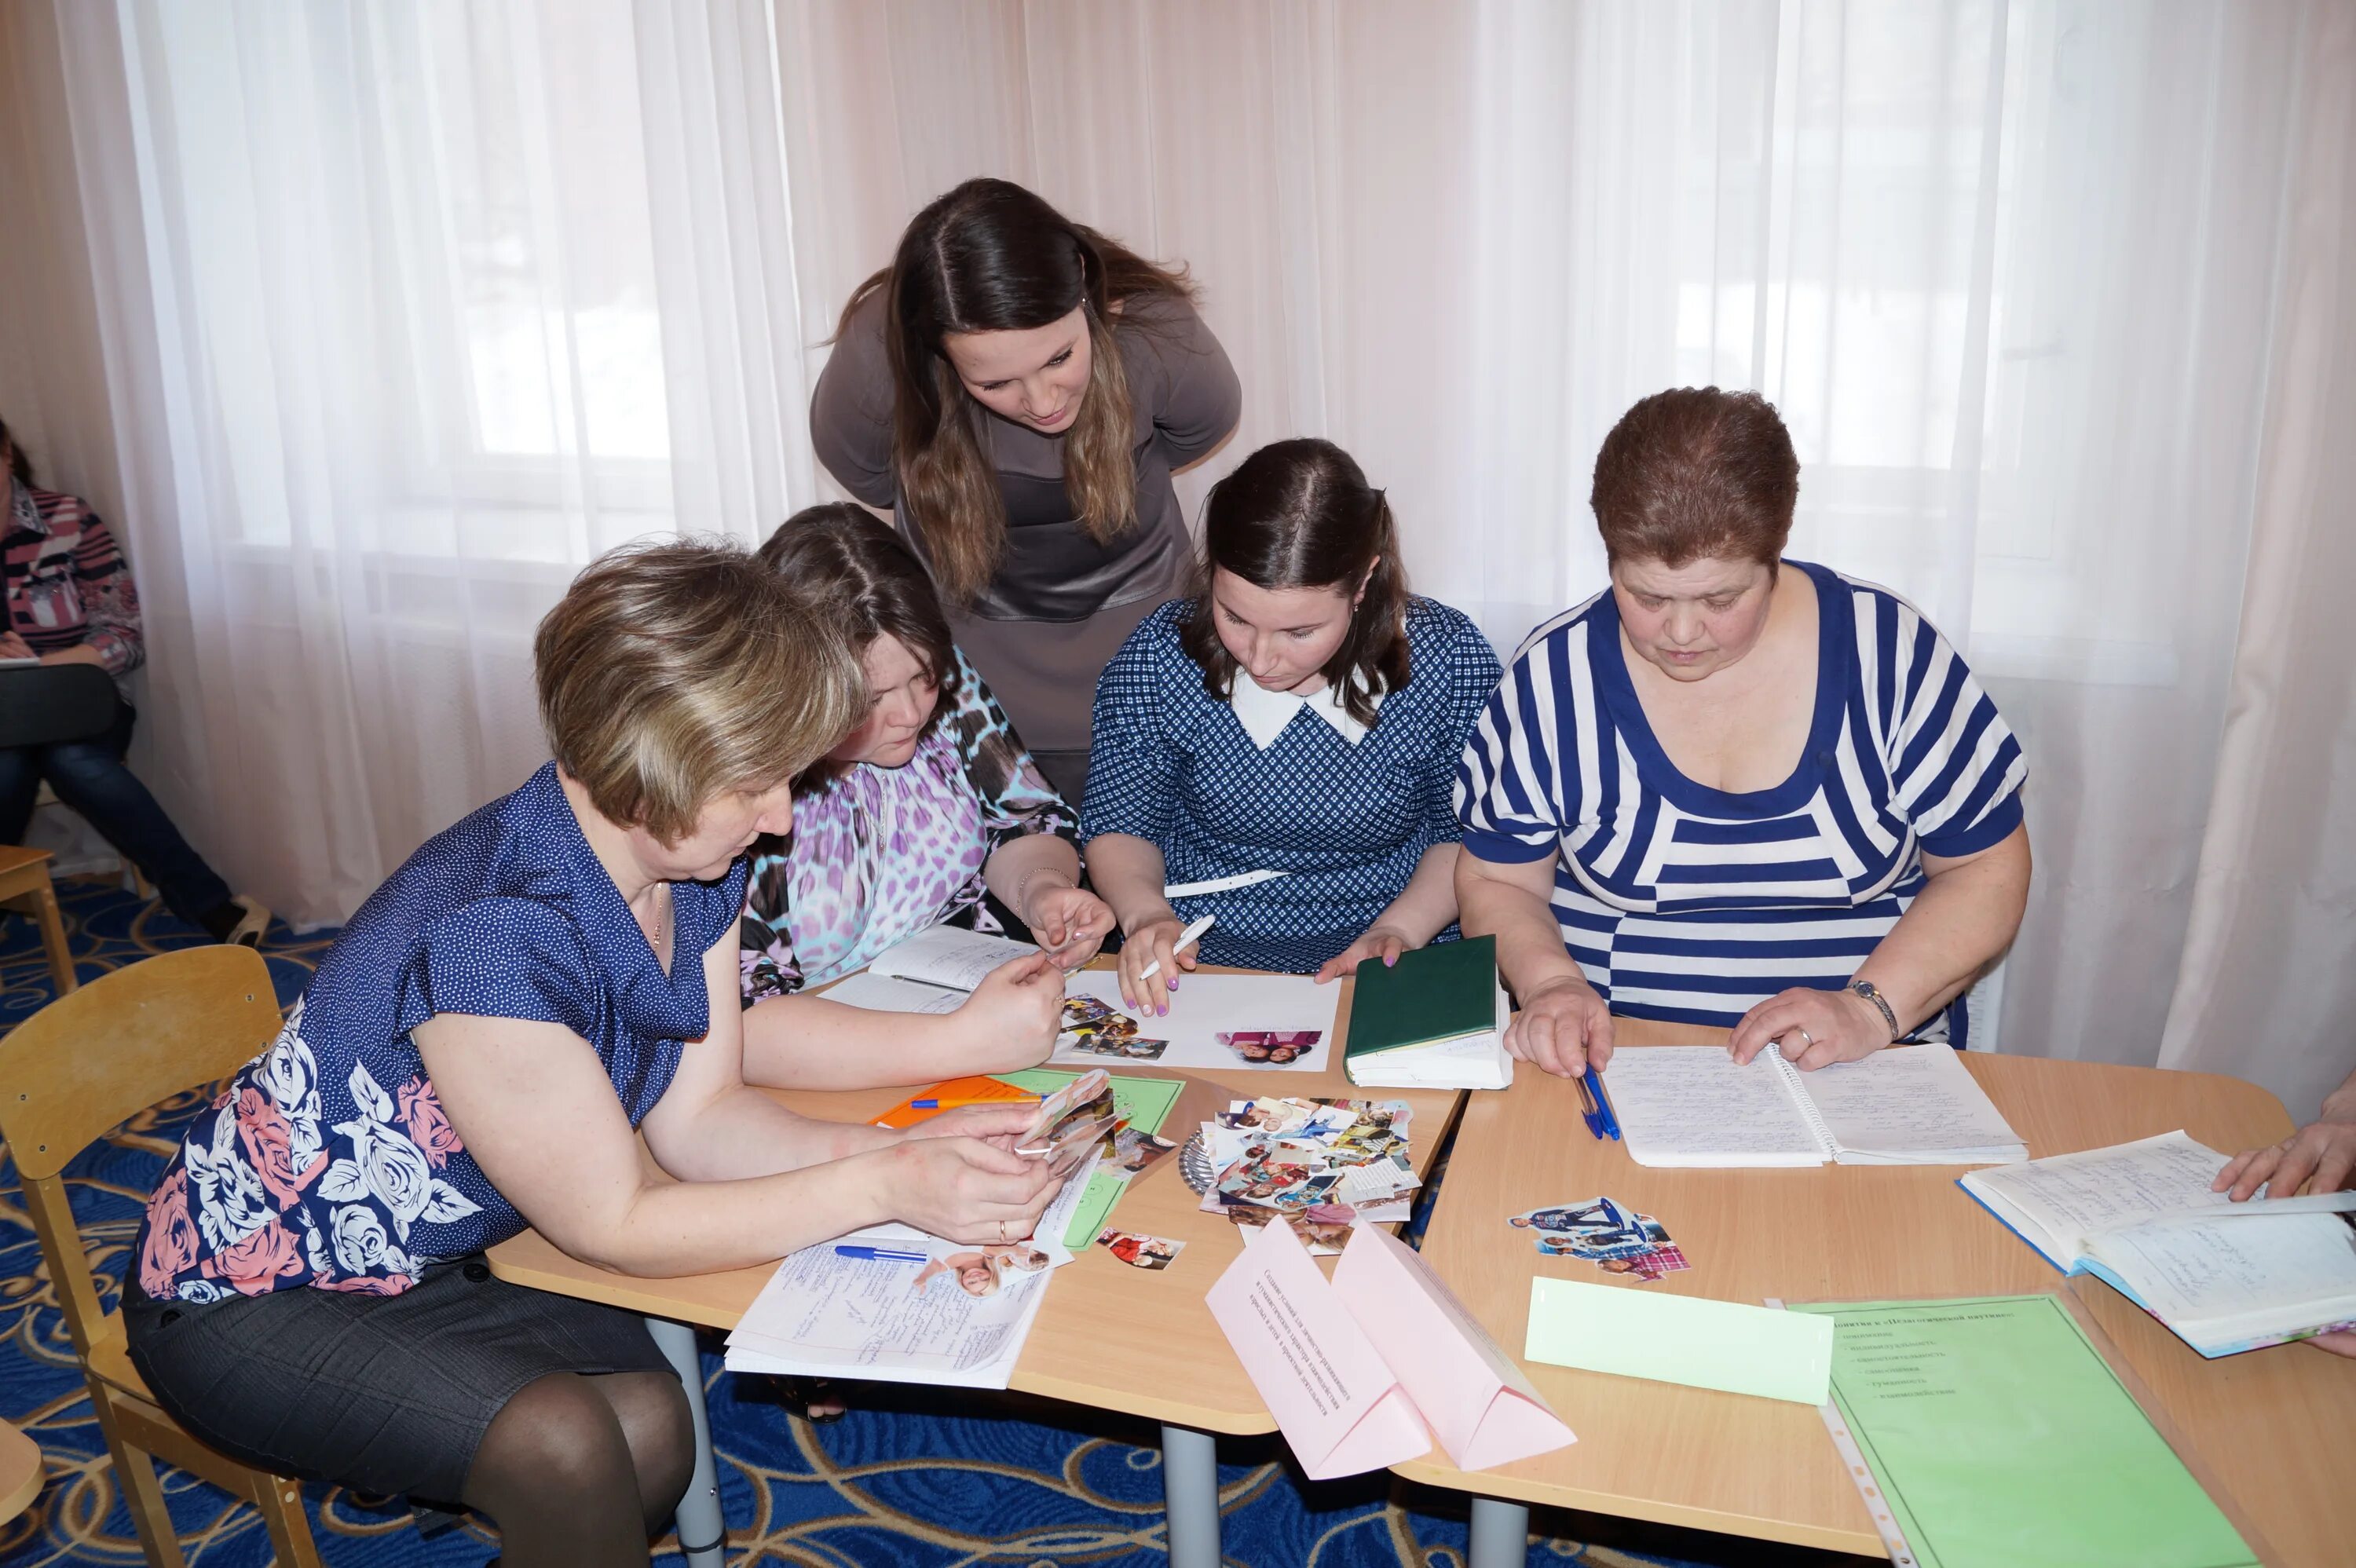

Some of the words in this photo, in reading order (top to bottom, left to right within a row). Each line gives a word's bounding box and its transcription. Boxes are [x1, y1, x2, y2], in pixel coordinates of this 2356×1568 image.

[1264, 1269, 1282, 1296] Создание
[1278, 1293, 1297, 1318] условий
[1249, 1293, 1267, 1320] взрослых
[1281, 1344, 1302, 1376] проектной
[1300, 1376, 1327, 1416] деятельности
[1289, 1332, 1309, 1363] характера
